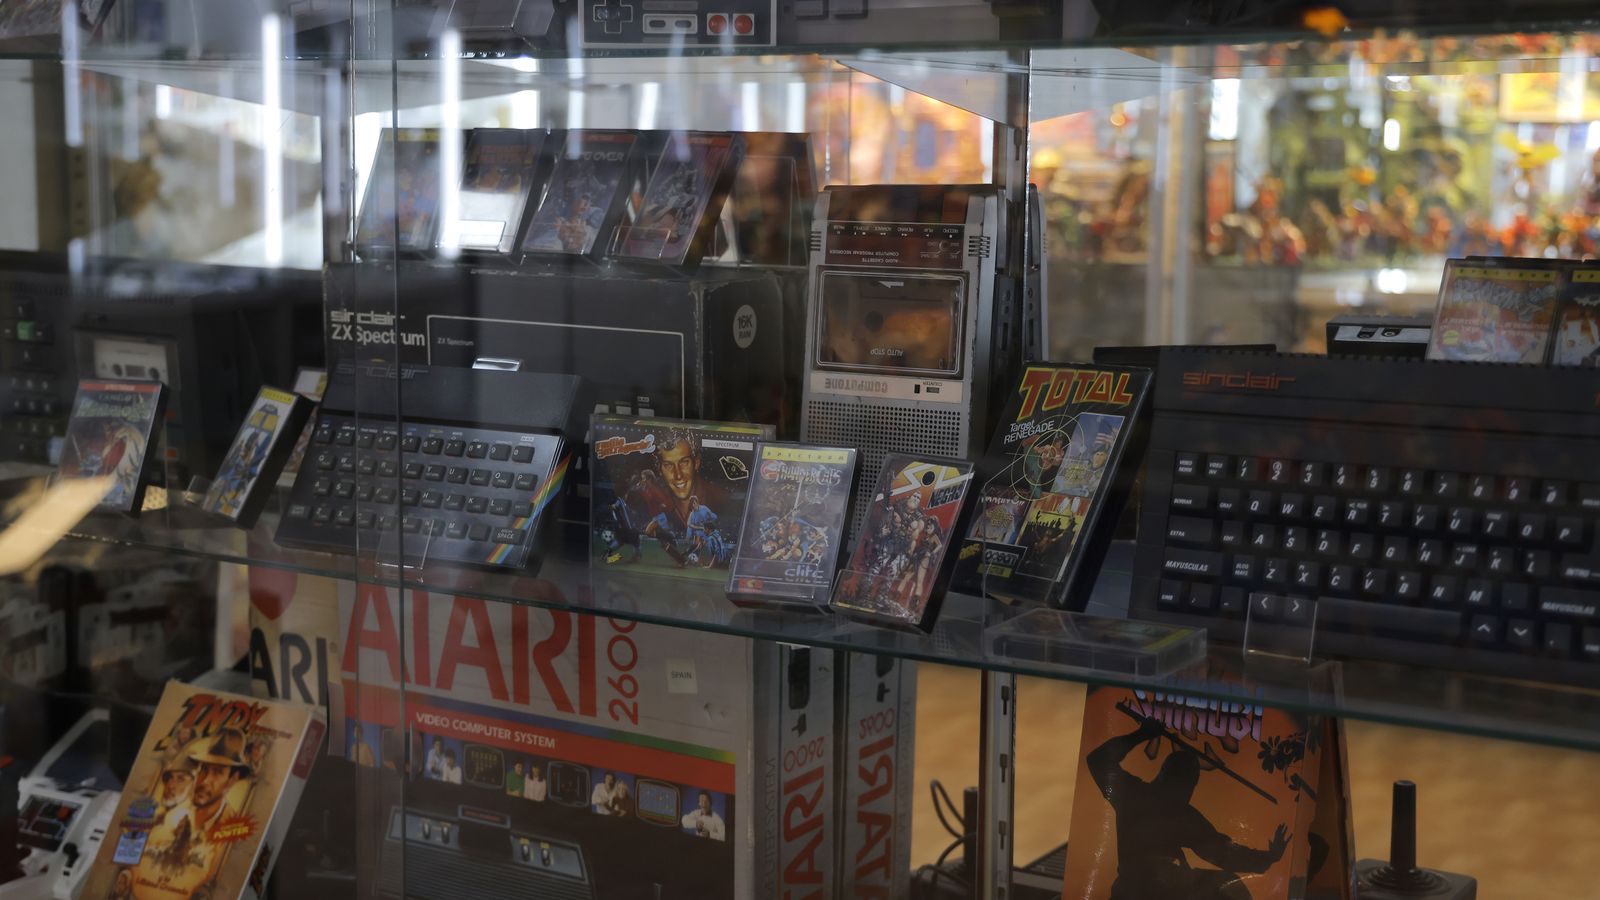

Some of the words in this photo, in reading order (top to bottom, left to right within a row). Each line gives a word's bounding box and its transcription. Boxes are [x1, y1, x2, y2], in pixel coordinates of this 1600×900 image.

[331, 324, 354, 341] ZX
[737, 314, 753, 330] 16K
[870, 348, 886, 356] STOP
[887, 349, 904, 357] AUTO
[1183, 370, 1296, 391] sinclair
[1016, 367, 1134, 422] TOTAL
[1003, 420, 1055, 445] RENEGADE
[1009, 420, 1036, 432] Target
[1304, 472, 1313, 483] 3
[1336, 475, 1345, 486] 4
[1250, 500, 1260, 512] Q
[1281, 503, 1294, 515] W
[1314, 506, 1324, 518] E
[1347, 509, 1357, 521] R
[1380, 512, 1390, 523] T
[1414, 515, 1425, 526] Y
[1450, 519, 1461, 530] U
[1559, 528, 1570, 540] P
[1254, 534, 1265, 545] A
[1286, 537, 1296, 549] S
[1318, 540, 1329, 551] D
[1351, 543, 1361, 555] F
[1385, 547, 1395, 559] G
[1420, 551, 1431, 562] H
[1455, 554, 1465, 566] J
[1490, 558, 1502, 570] K
[1165, 560, 1209, 572] MAYUSCULAS
[1266, 568, 1276, 579] Z
[1298, 572, 1309, 583] X
[1331, 575, 1341, 587] C
[1364, 579, 1374, 590] V
[1433, 586, 1445, 598] N
[1469, 590, 1483, 602] M
[607, 592, 639, 725] 2600
[671, 671, 693, 680] SPAIN
[170, 694, 268, 743] INDY
[415, 712, 451, 729] VIDEO
[452, 719, 511, 740] COMPUTER
[513, 731, 556, 749] SYSTEM
[783, 736, 825, 773] 2600
